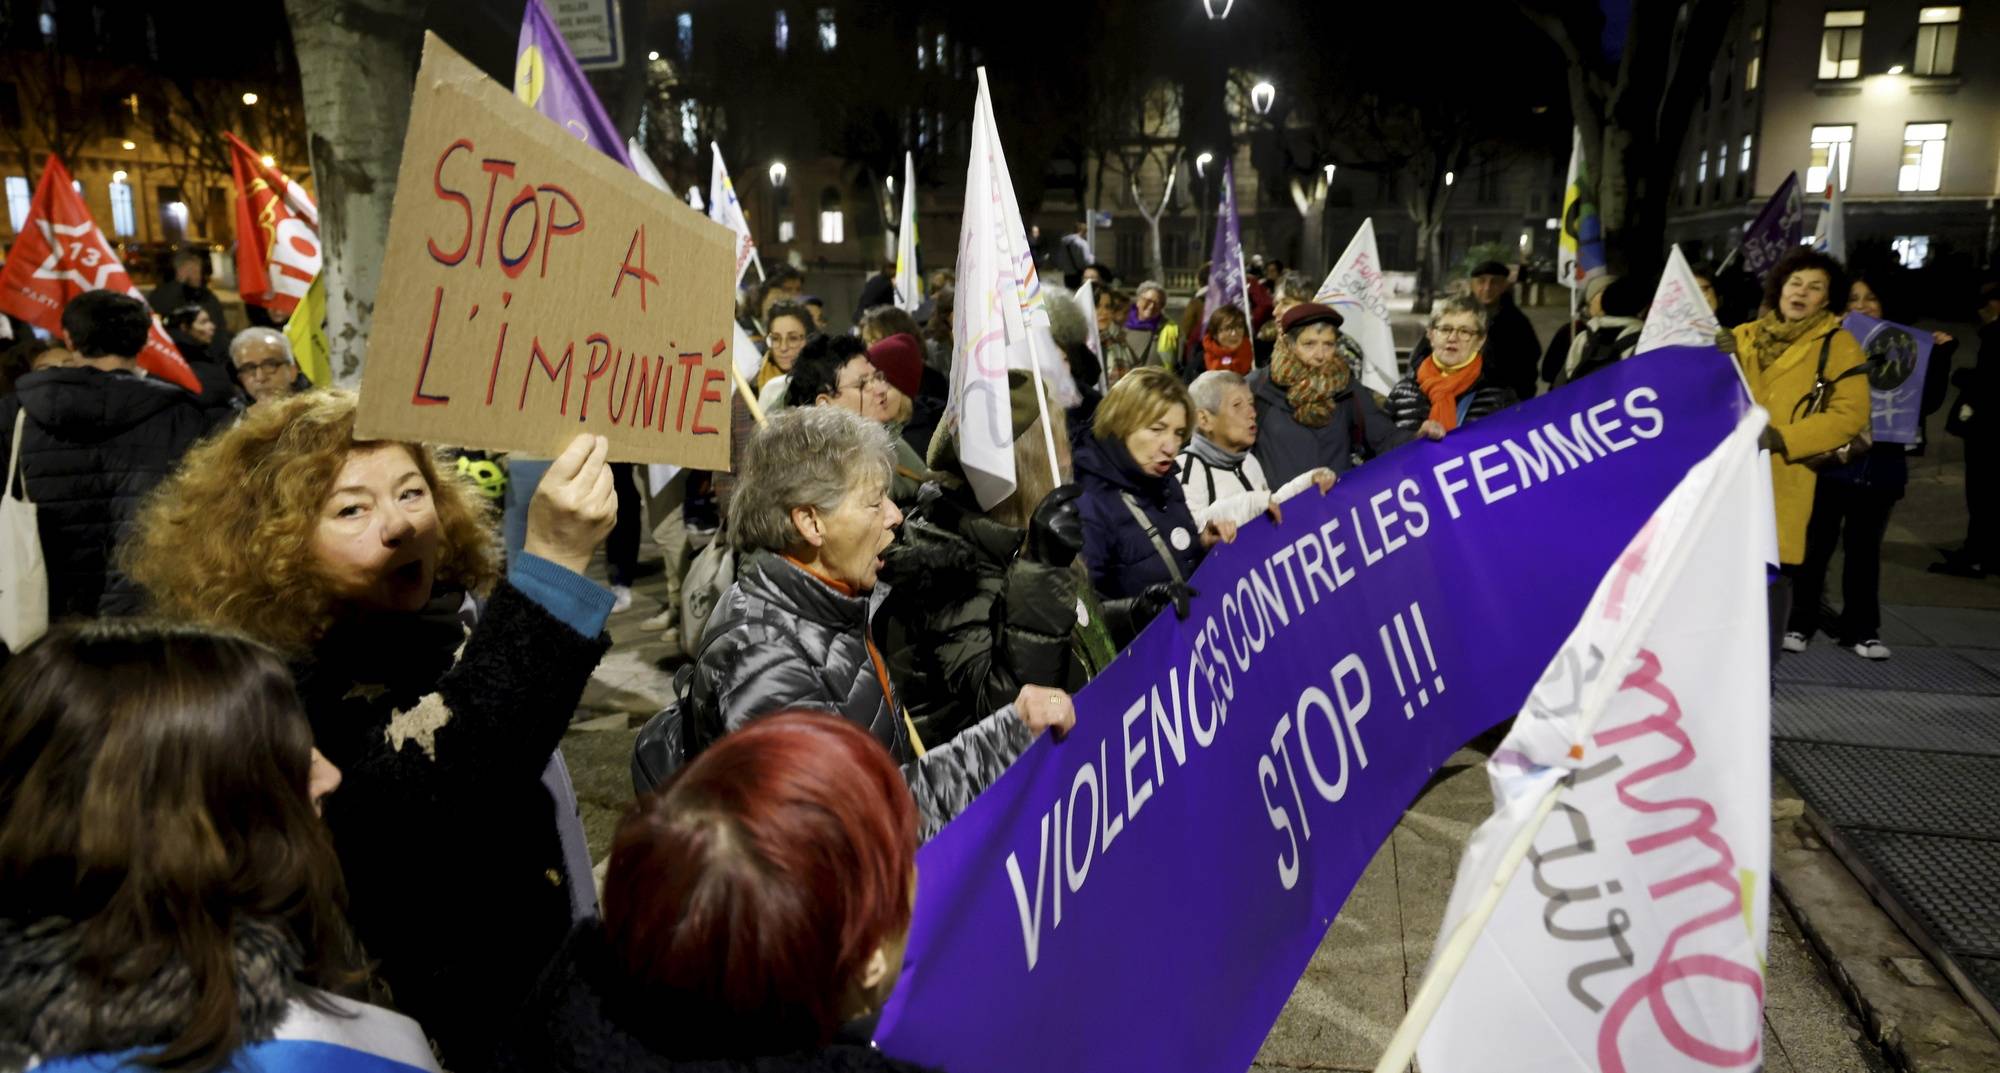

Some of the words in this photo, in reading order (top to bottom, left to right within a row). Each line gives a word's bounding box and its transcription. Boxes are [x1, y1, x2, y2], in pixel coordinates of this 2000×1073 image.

[69, 242, 102, 267] 13
[426, 138, 585, 280] STOP
[1006, 615, 1235, 972] VIOLENCES
[1222, 518, 1356, 673] CONTRE
[1351, 478, 1430, 568] LES
[1433, 387, 1664, 520] FEMMES
[1258, 653, 1372, 890] STOP
